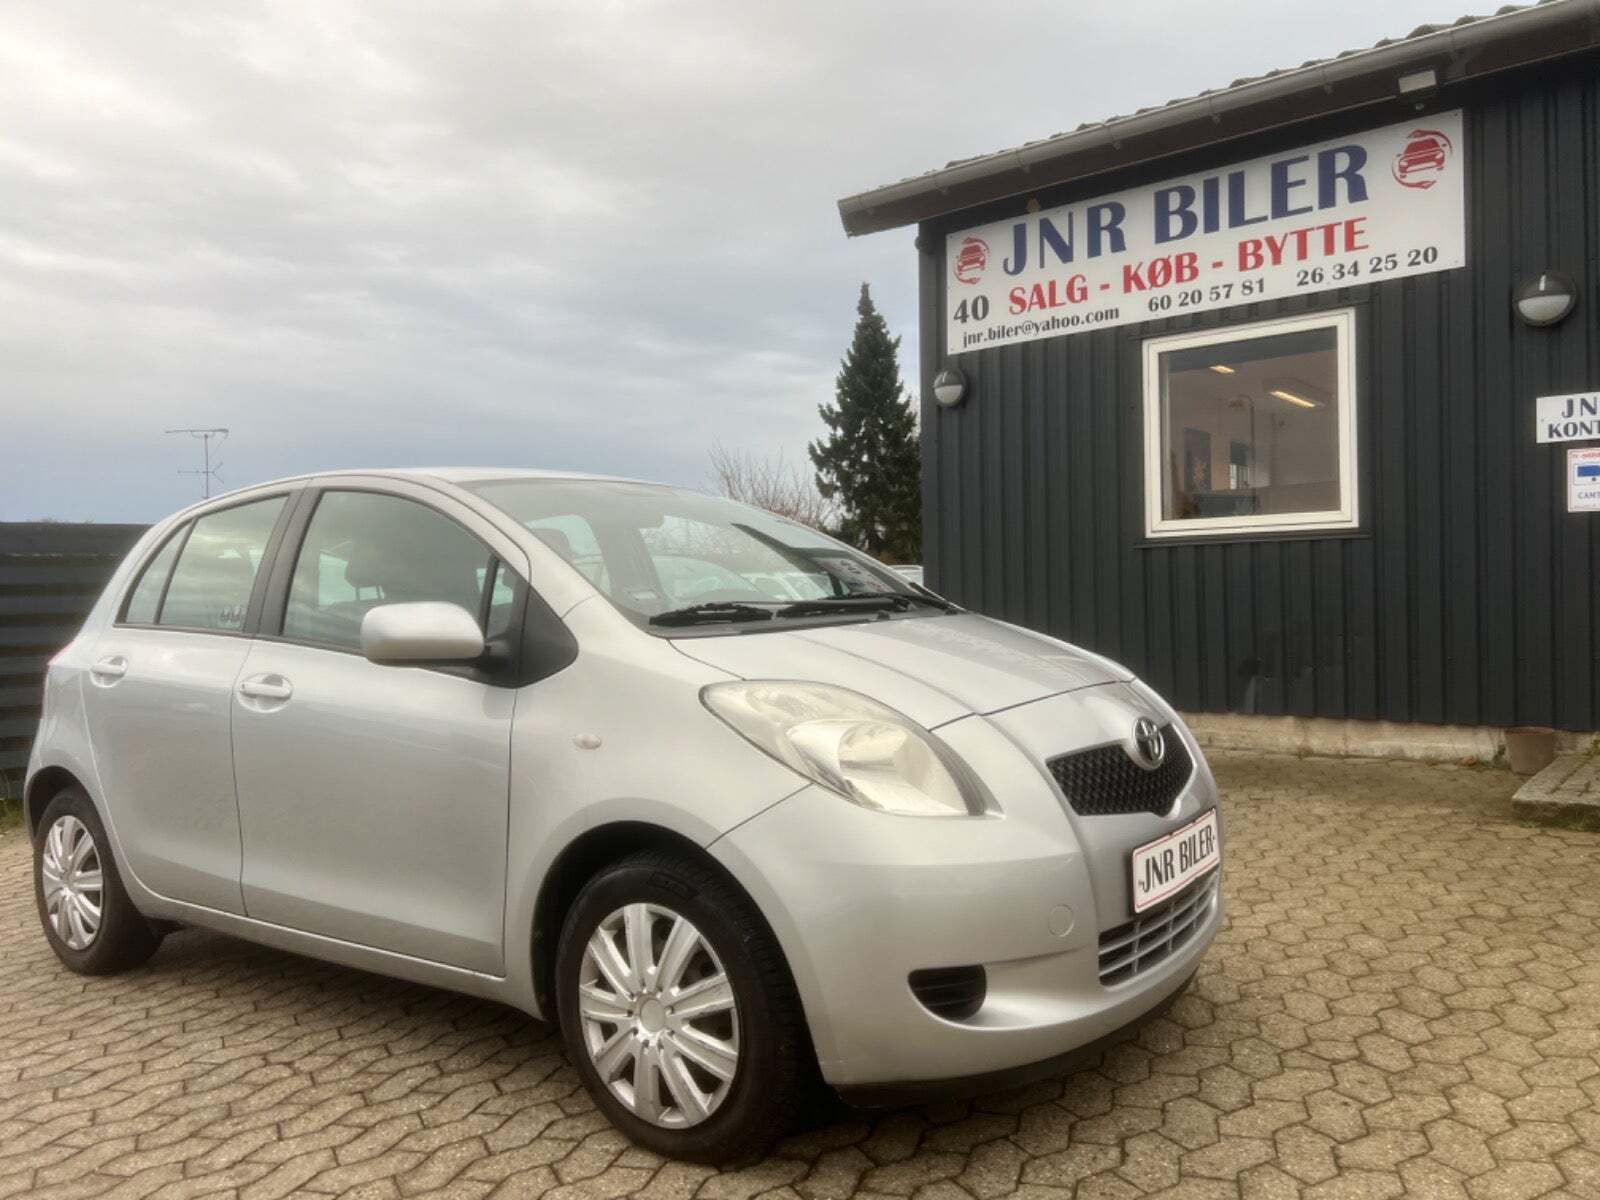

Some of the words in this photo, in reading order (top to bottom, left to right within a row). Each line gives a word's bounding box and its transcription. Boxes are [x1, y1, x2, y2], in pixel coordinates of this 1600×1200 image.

[1003, 202, 1126, 276] JNR
[1154, 144, 1369, 245] BILER
[1009, 274, 1089, 316] SALG
[1123, 252, 1199, 294] KØB
[1238, 216, 1370, 273] BYTTE
[1297, 267, 1324, 287] 26
[1332, 260, 1360, 280] 34
[1369, 253, 1398, 274] 25
[1407, 246, 1438, 267] 20
[953, 295, 990, 324] 40
[1148, 294, 1172, 312] 60
[1178, 289, 1202, 307] 20
[1209, 283, 1234, 302] 57
[1241, 278, 1265, 296] 81
[962, 307, 1120, 348] jnr.biler@yahoo.com
[1141, 848, 1175, 893] JNR
[1178, 824, 1214, 873] BILER
